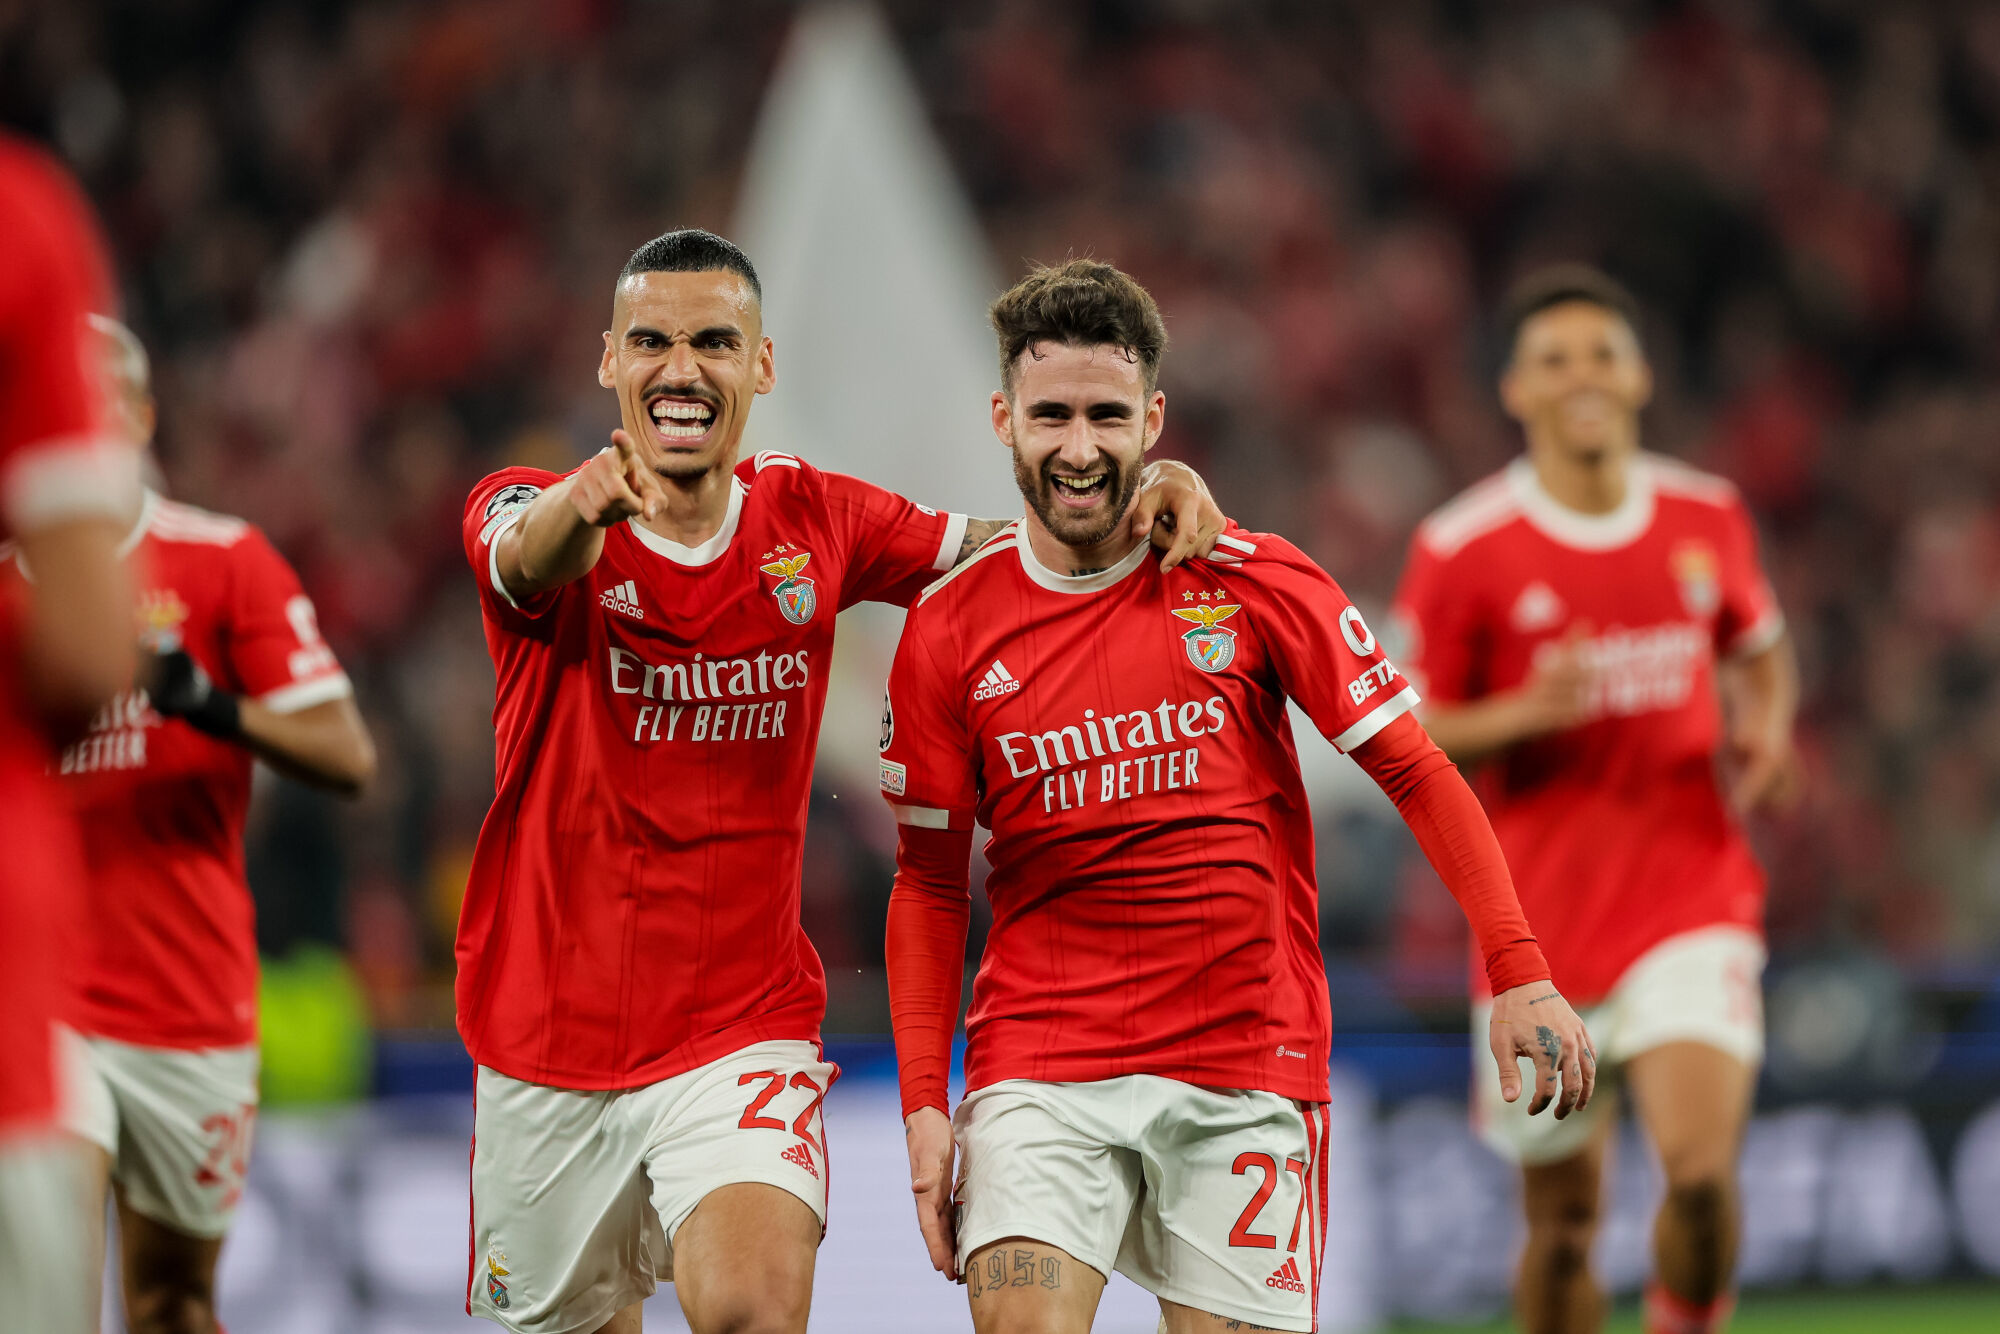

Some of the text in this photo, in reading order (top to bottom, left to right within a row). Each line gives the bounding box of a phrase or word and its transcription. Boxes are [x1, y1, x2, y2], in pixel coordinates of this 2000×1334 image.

[599, 594, 644, 619] adidas
[609, 647, 809, 701] Emirates
[973, 680, 1020, 701] adidas
[1347, 658, 1400, 707] BETA
[634, 700, 787, 742] FLY BETTER
[994, 695, 1225, 779] Emirates
[1043, 747, 1200, 813] FLY BETTER
[738, 1070, 823, 1157] 22
[780, 1151, 820, 1181] adidas
[1229, 1151, 1305, 1253] 27
[968, 1248, 1062, 1299] 1959
[1265, 1276, 1306, 1295] adidas
